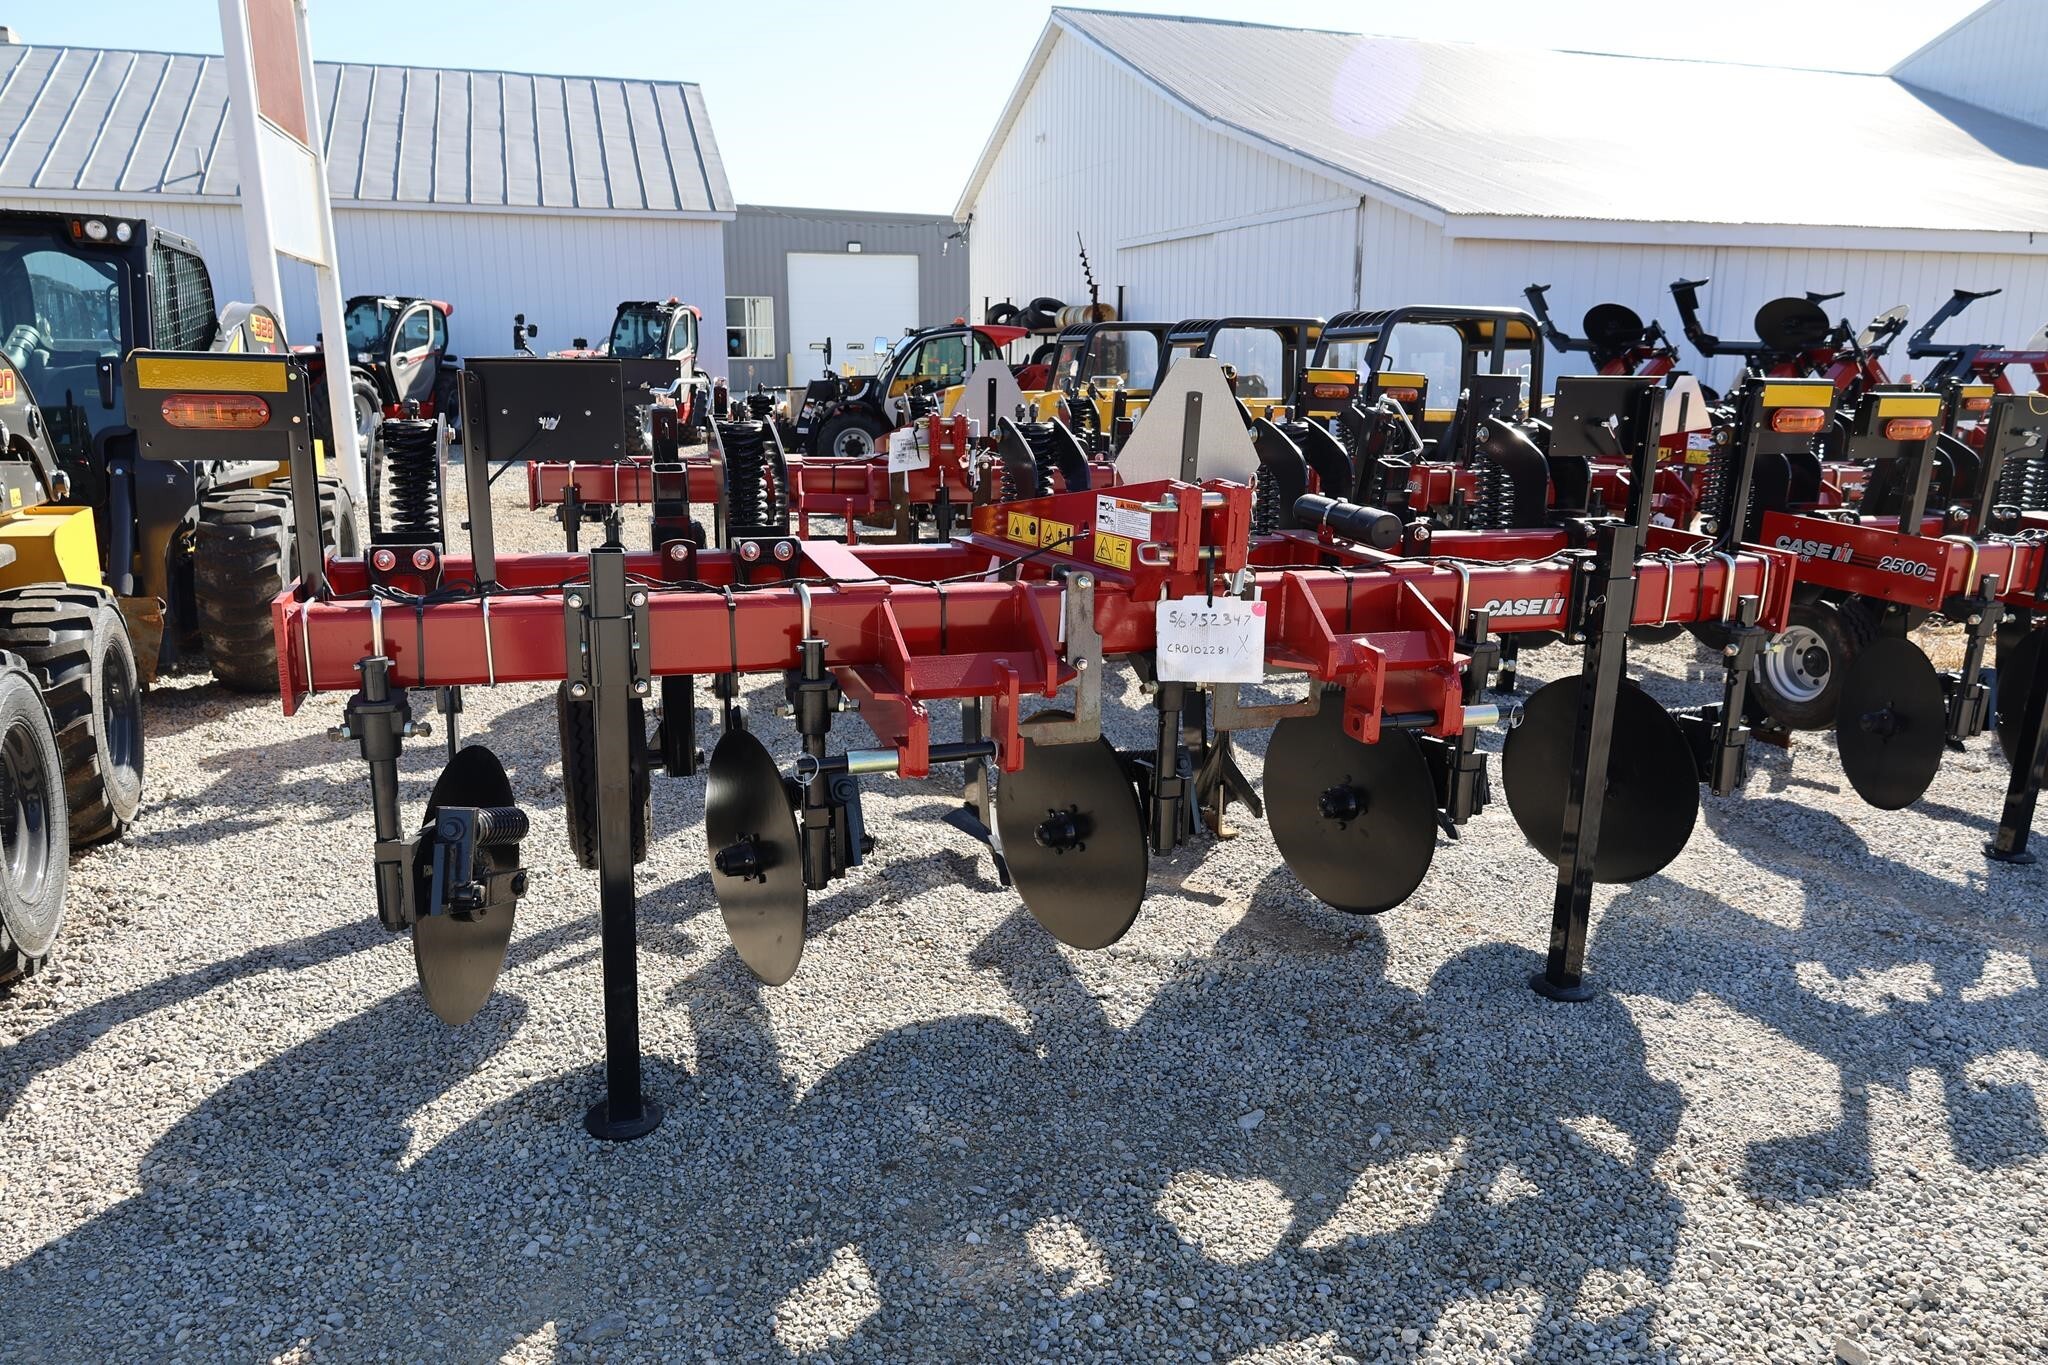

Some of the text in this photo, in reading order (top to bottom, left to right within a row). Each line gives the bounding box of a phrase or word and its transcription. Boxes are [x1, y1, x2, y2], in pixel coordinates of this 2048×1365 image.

[1775, 535, 1830, 559] CASE
[1876, 555, 1928, 578] 2500
[1484, 599, 1544, 617] CASE
